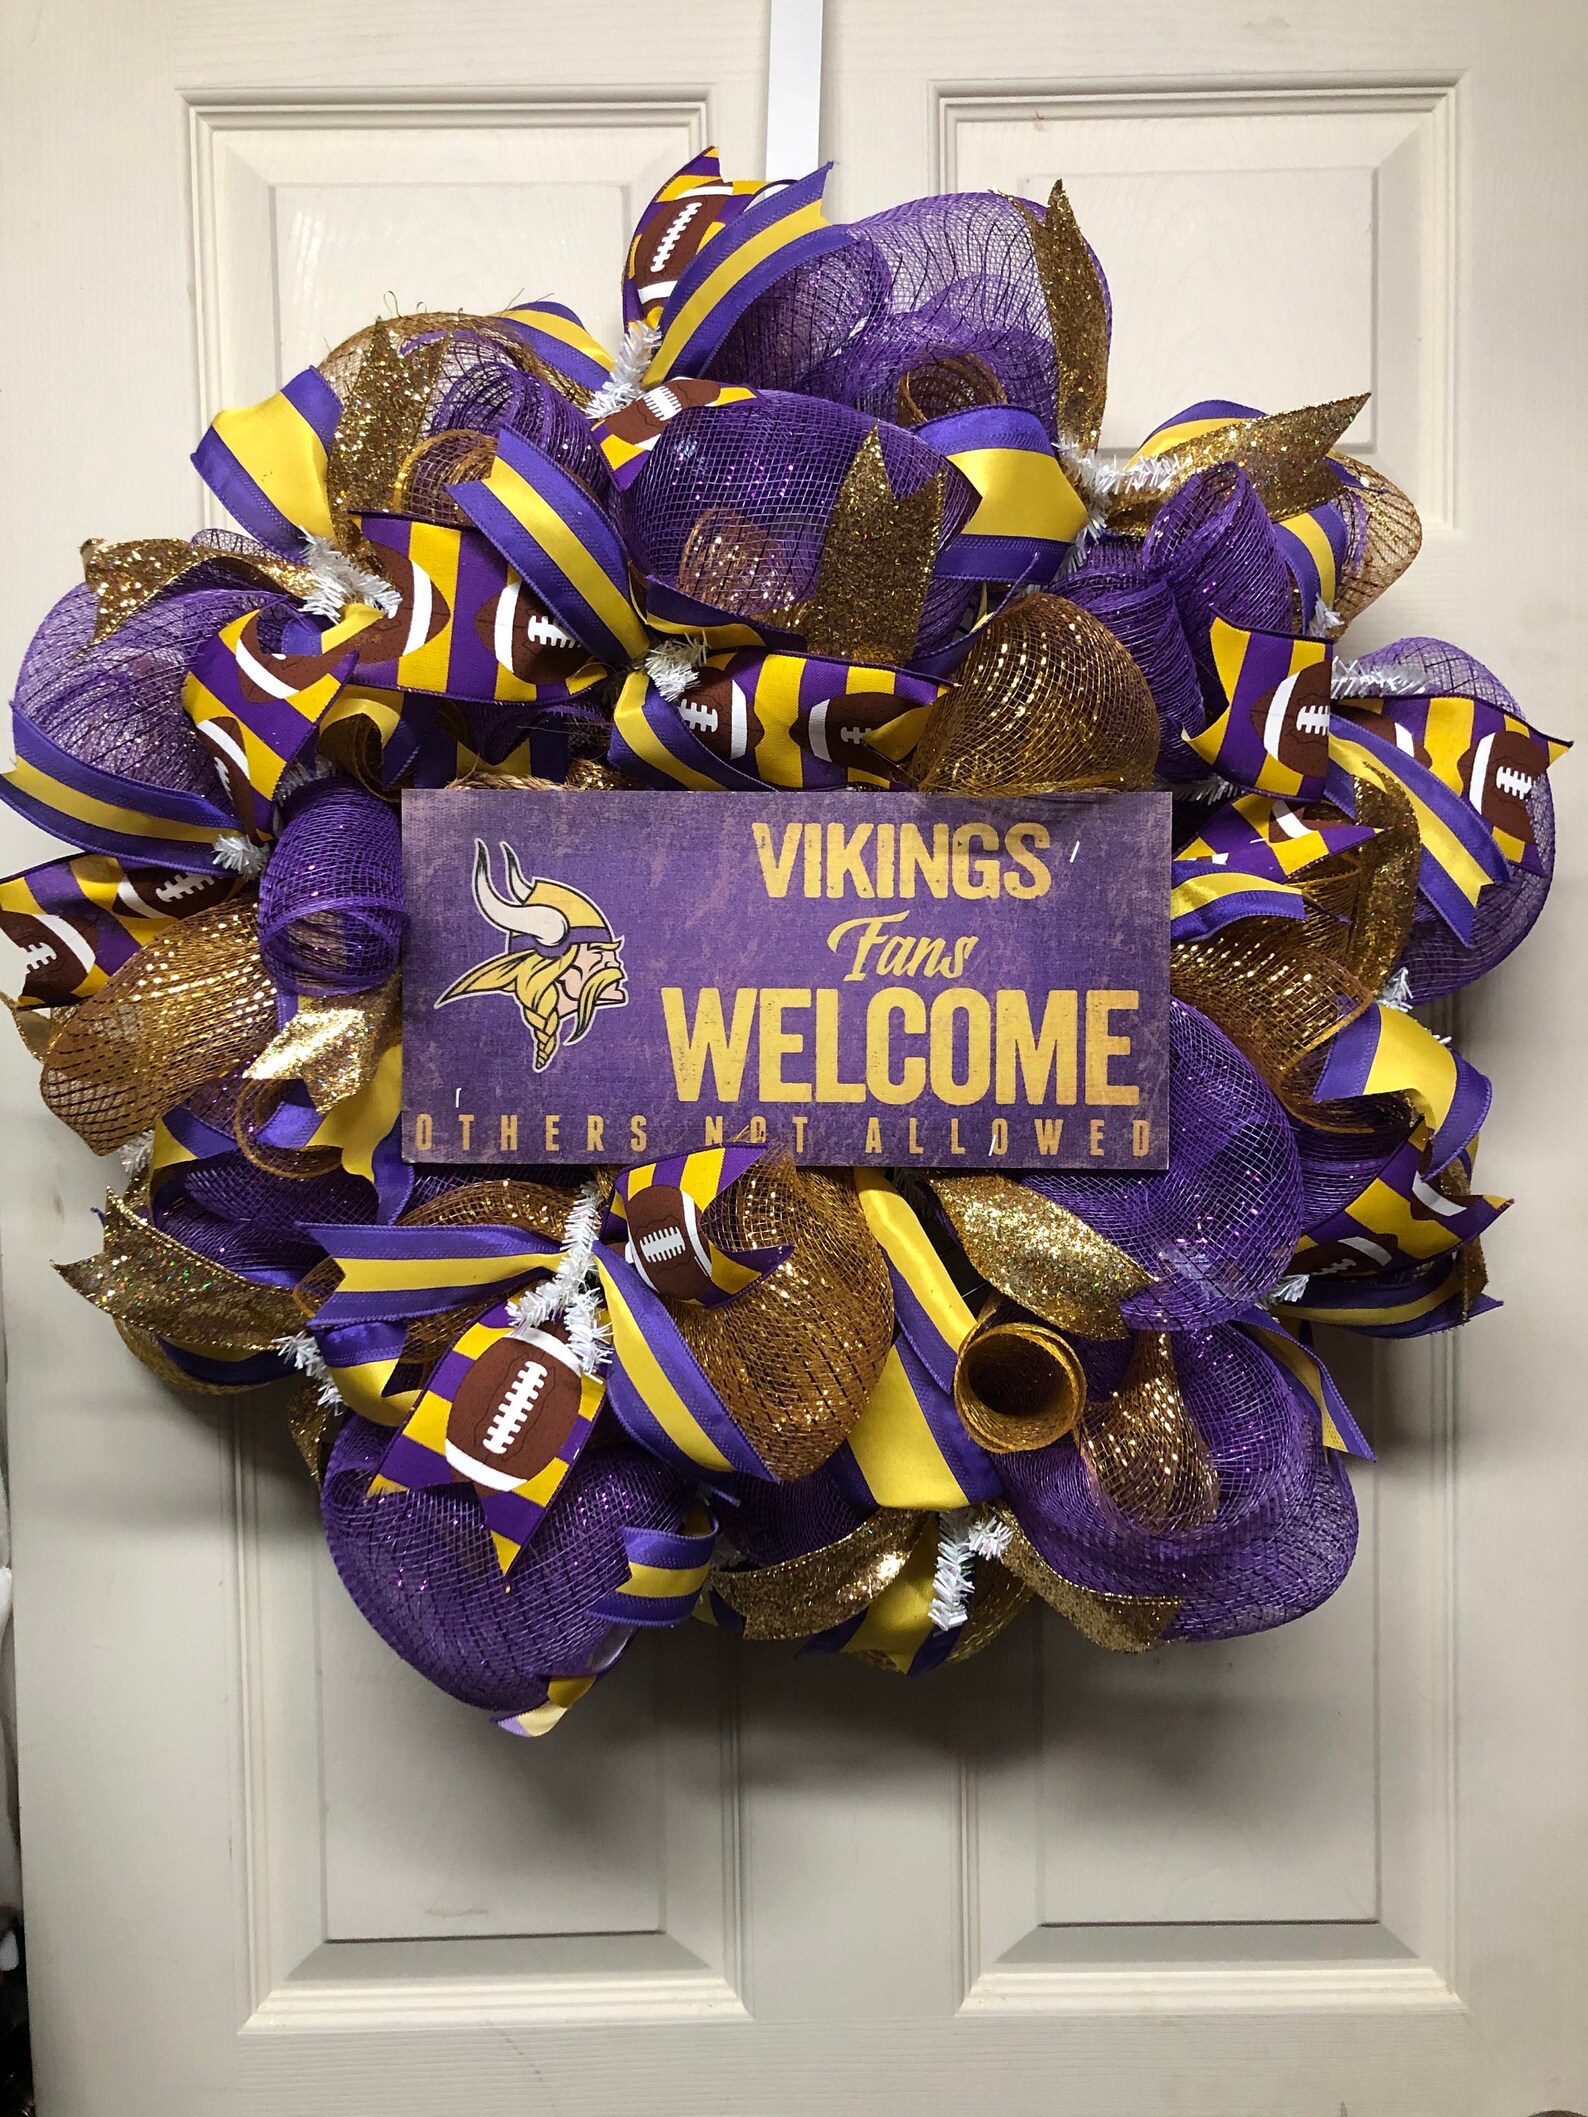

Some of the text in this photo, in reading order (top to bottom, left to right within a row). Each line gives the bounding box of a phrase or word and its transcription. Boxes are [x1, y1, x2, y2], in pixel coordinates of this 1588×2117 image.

[752, 822, 1052, 899] VIKINGS
[826, 910, 979, 982] Fans
[660, 987, 1140, 1105] WELCOME
[414, 1113, 1151, 1157] OTHERS NOT ALLOWED
